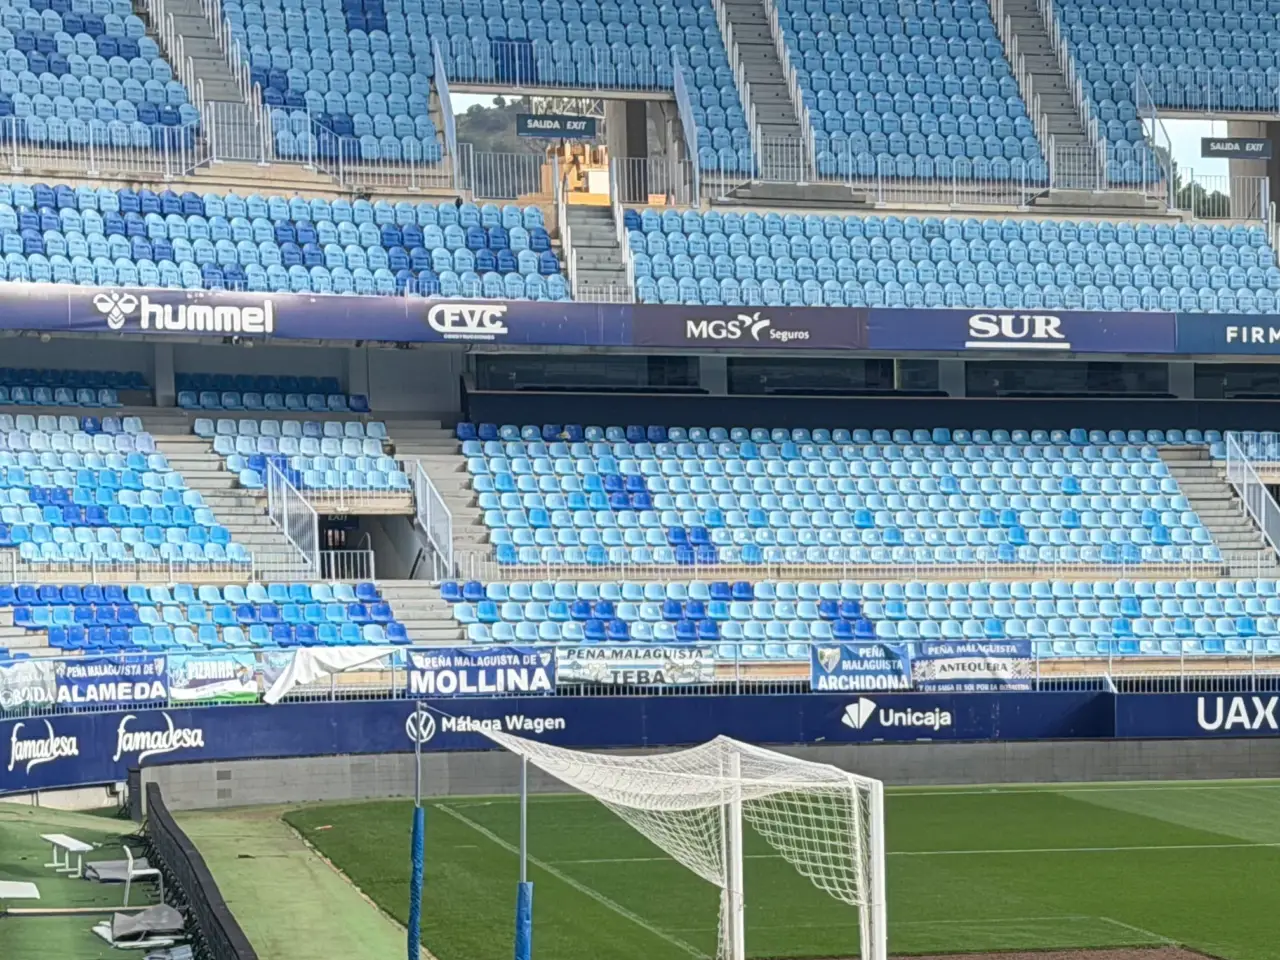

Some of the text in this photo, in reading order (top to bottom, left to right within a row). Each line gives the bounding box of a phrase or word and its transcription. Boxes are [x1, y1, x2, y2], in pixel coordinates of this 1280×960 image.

[527, 118, 587, 131] SALIDA EXIT
[1210, 142, 1264, 152] SALIDA EXIT
[140, 299, 274, 334] hummel
[686, 319, 810, 341] MGS Seguros
[968, 314, 1065, 339] SUR
[610, 649, 703, 660] MALAGUISTA
[859, 646, 885, 658] PEÑA
[928, 643, 1018, 656] PEÑA MALAGUISTA
[425, 654, 537, 668] PEÑA MALAGUISTA DE
[842, 659, 904, 671] MALAGUISTA
[939, 661, 1009, 673] ANTEQUERA
[67, 663, 86, 678] PEÑA
[143, 663, 154, 675] DE
[611, 670, 667, 685] TEBA
[410, 668, 551, 693] MOLLINA
[818, 674, 911, 691] ARCHIDONA
[57, 680, 167, 703] ALAMEDA
[879, 707, 952, 730] Unicaja
[1198, 696, 1278, 730] UAX
[505, 714, 566, 734] Wagen
[113, 711, 205, 764] famadesa
[8, 719, 79, 775] famadesa
